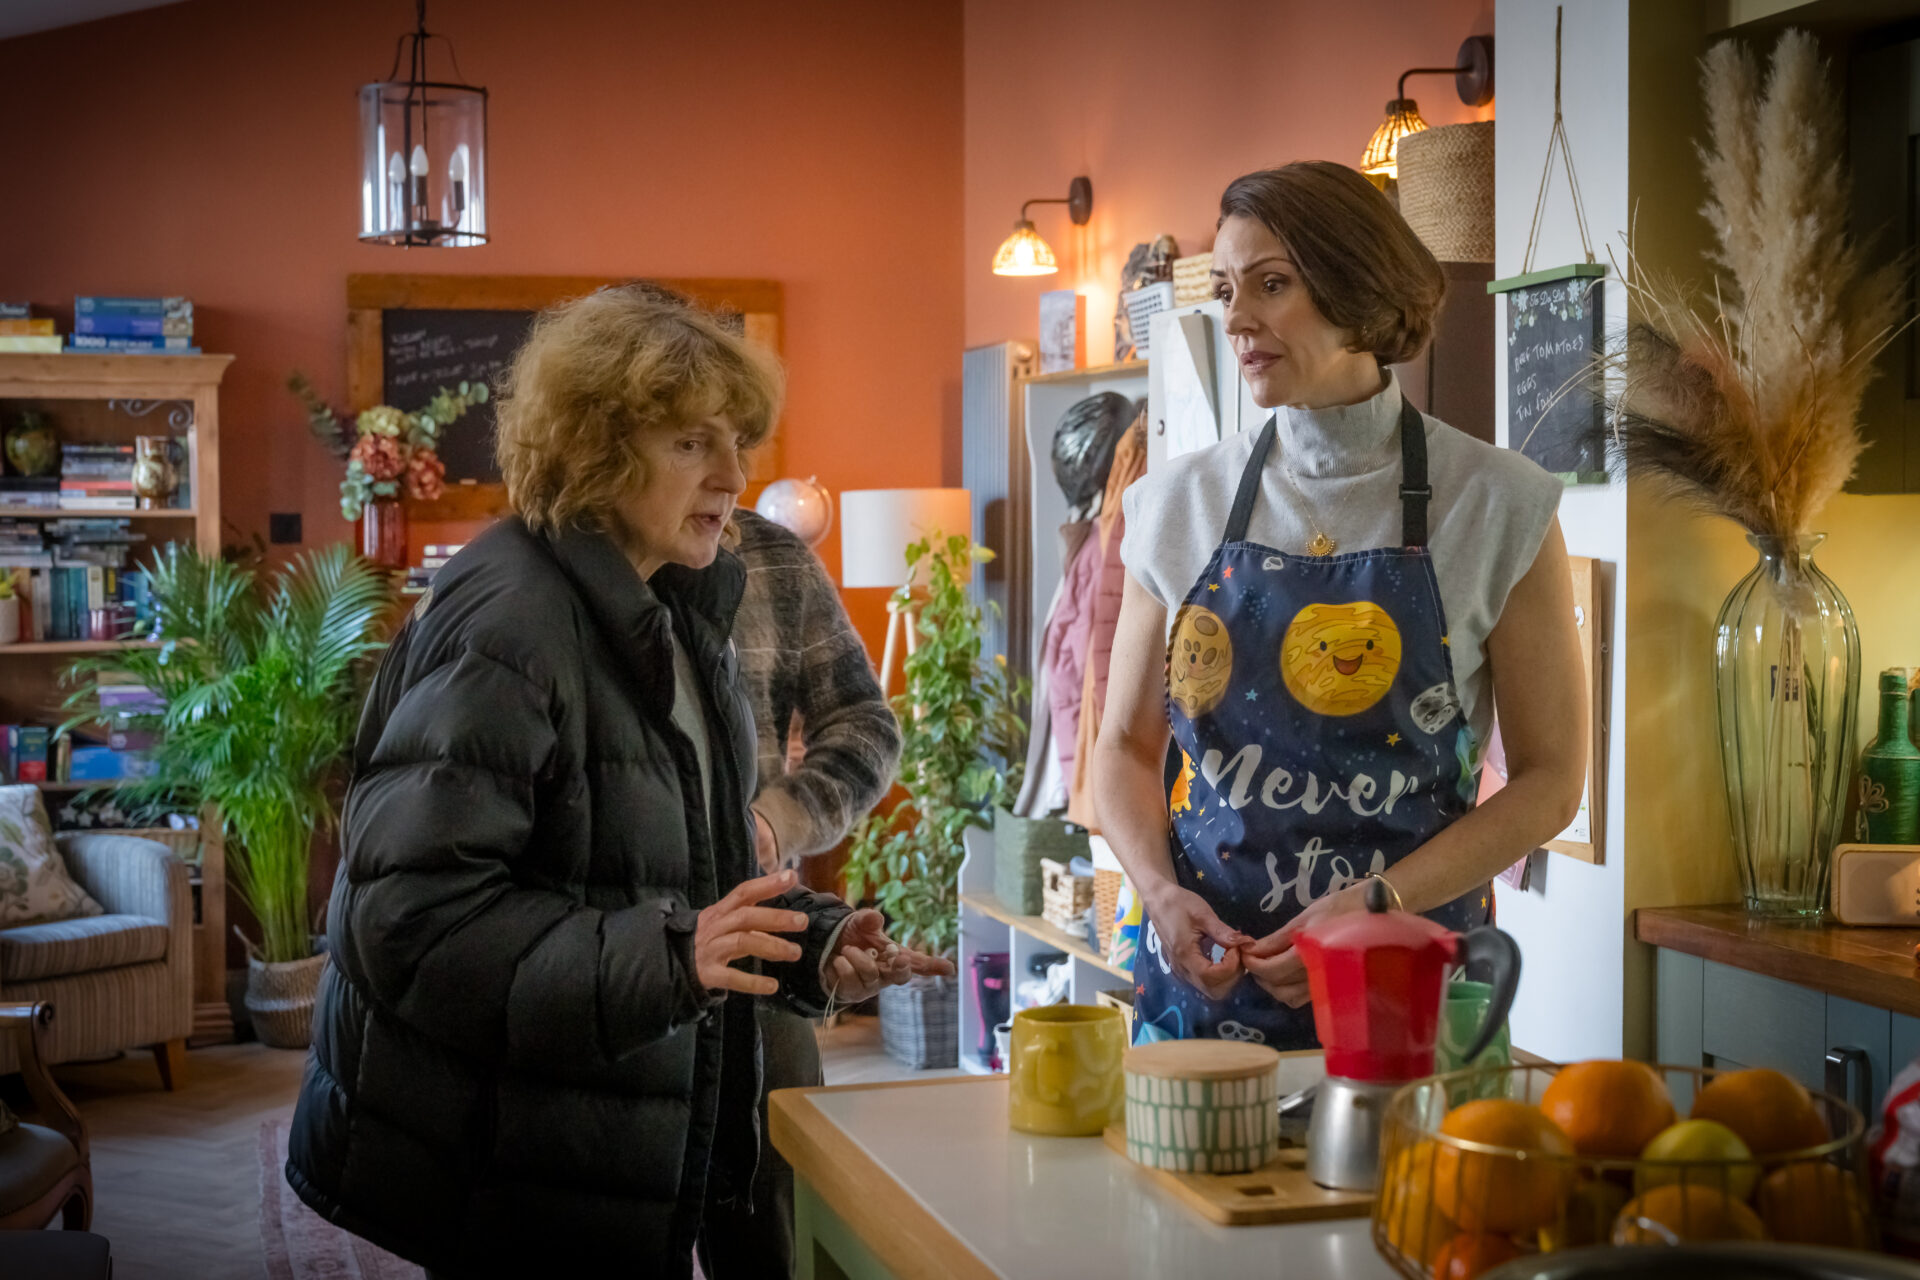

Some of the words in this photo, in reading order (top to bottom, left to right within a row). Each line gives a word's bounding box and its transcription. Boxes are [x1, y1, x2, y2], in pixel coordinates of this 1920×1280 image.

[1529, 291, 1540, 307] To
[1540, 290, 1551, 306] Do
[1552, 288, 1566, 303] List
[1532, 334, 1584, 361] TOMATOES
[1516, 373, 1537, 396] EGGS
[1201, 744, 1419, 817] Never
